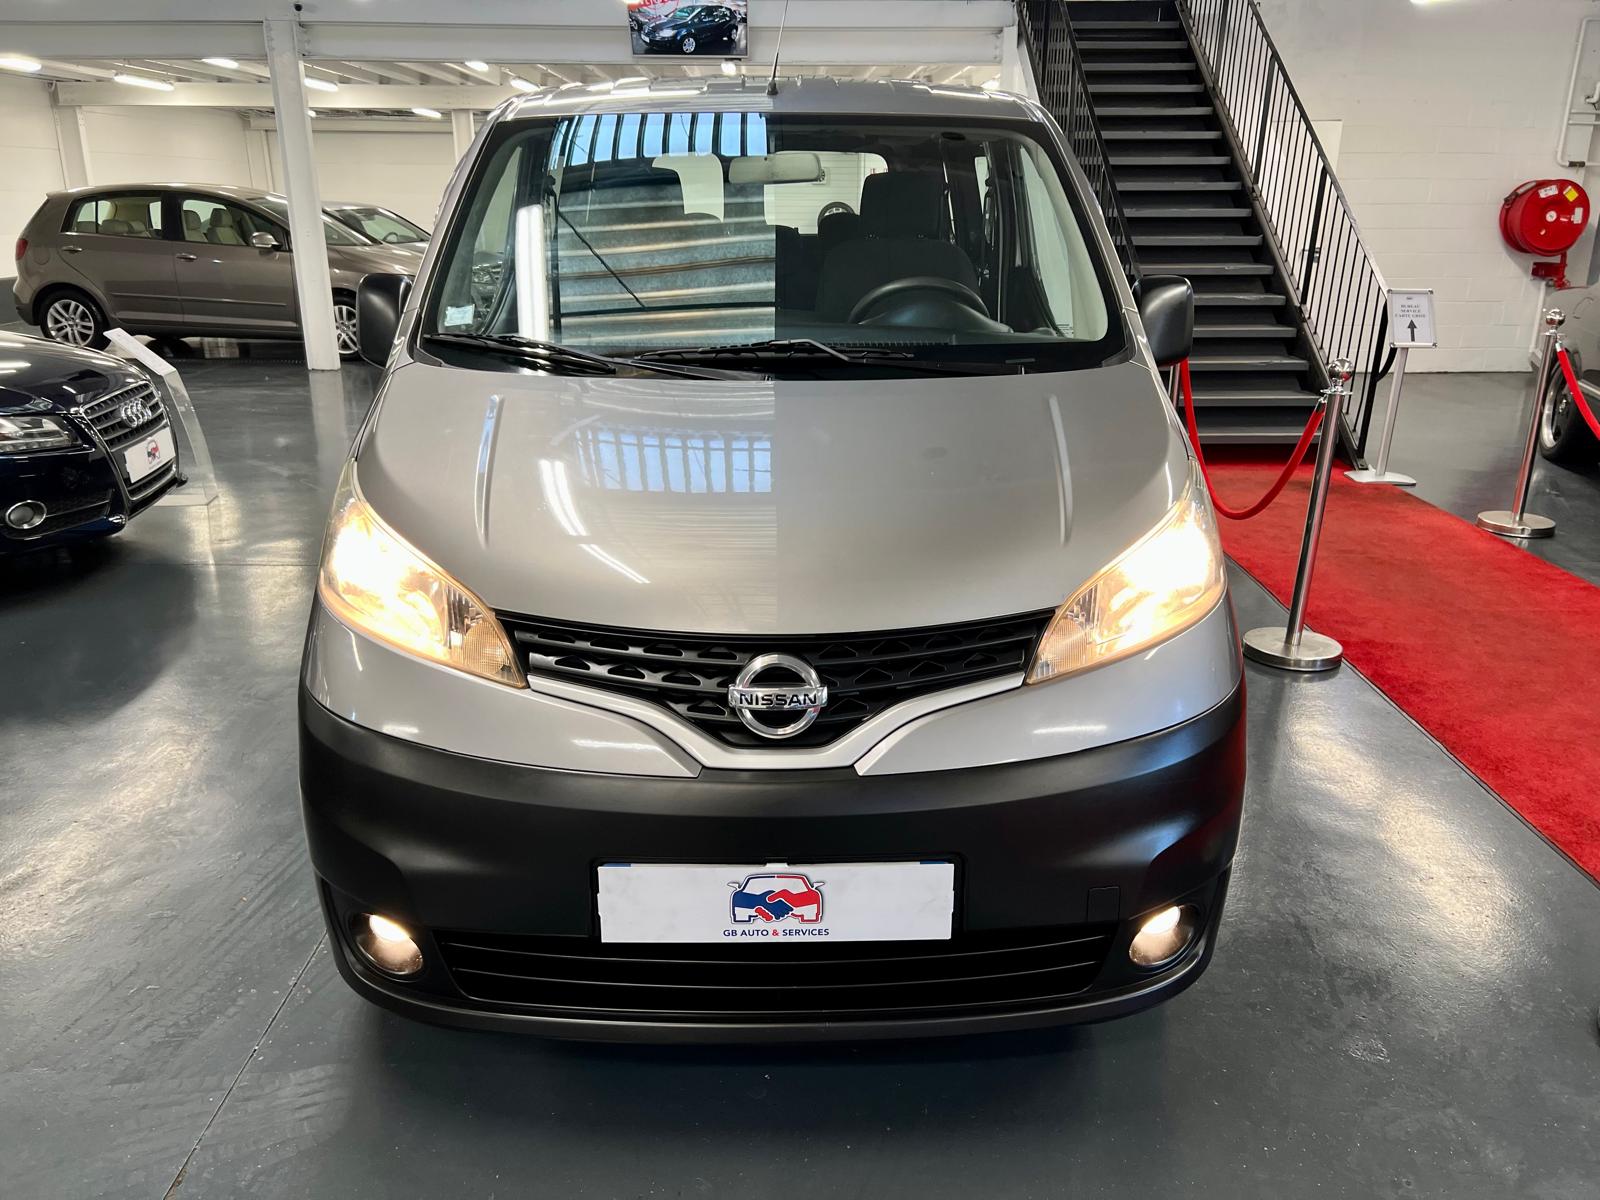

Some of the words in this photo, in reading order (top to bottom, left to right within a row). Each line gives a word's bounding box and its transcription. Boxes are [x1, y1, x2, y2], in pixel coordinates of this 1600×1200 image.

[739, 693, 817, 706] NISSAN
[723, 929, 738, 937] GB
[740, 929, 769, 937] AUTO
[772, 928, 780, 937] &
[782, 928, 830, 937] SERVICES
